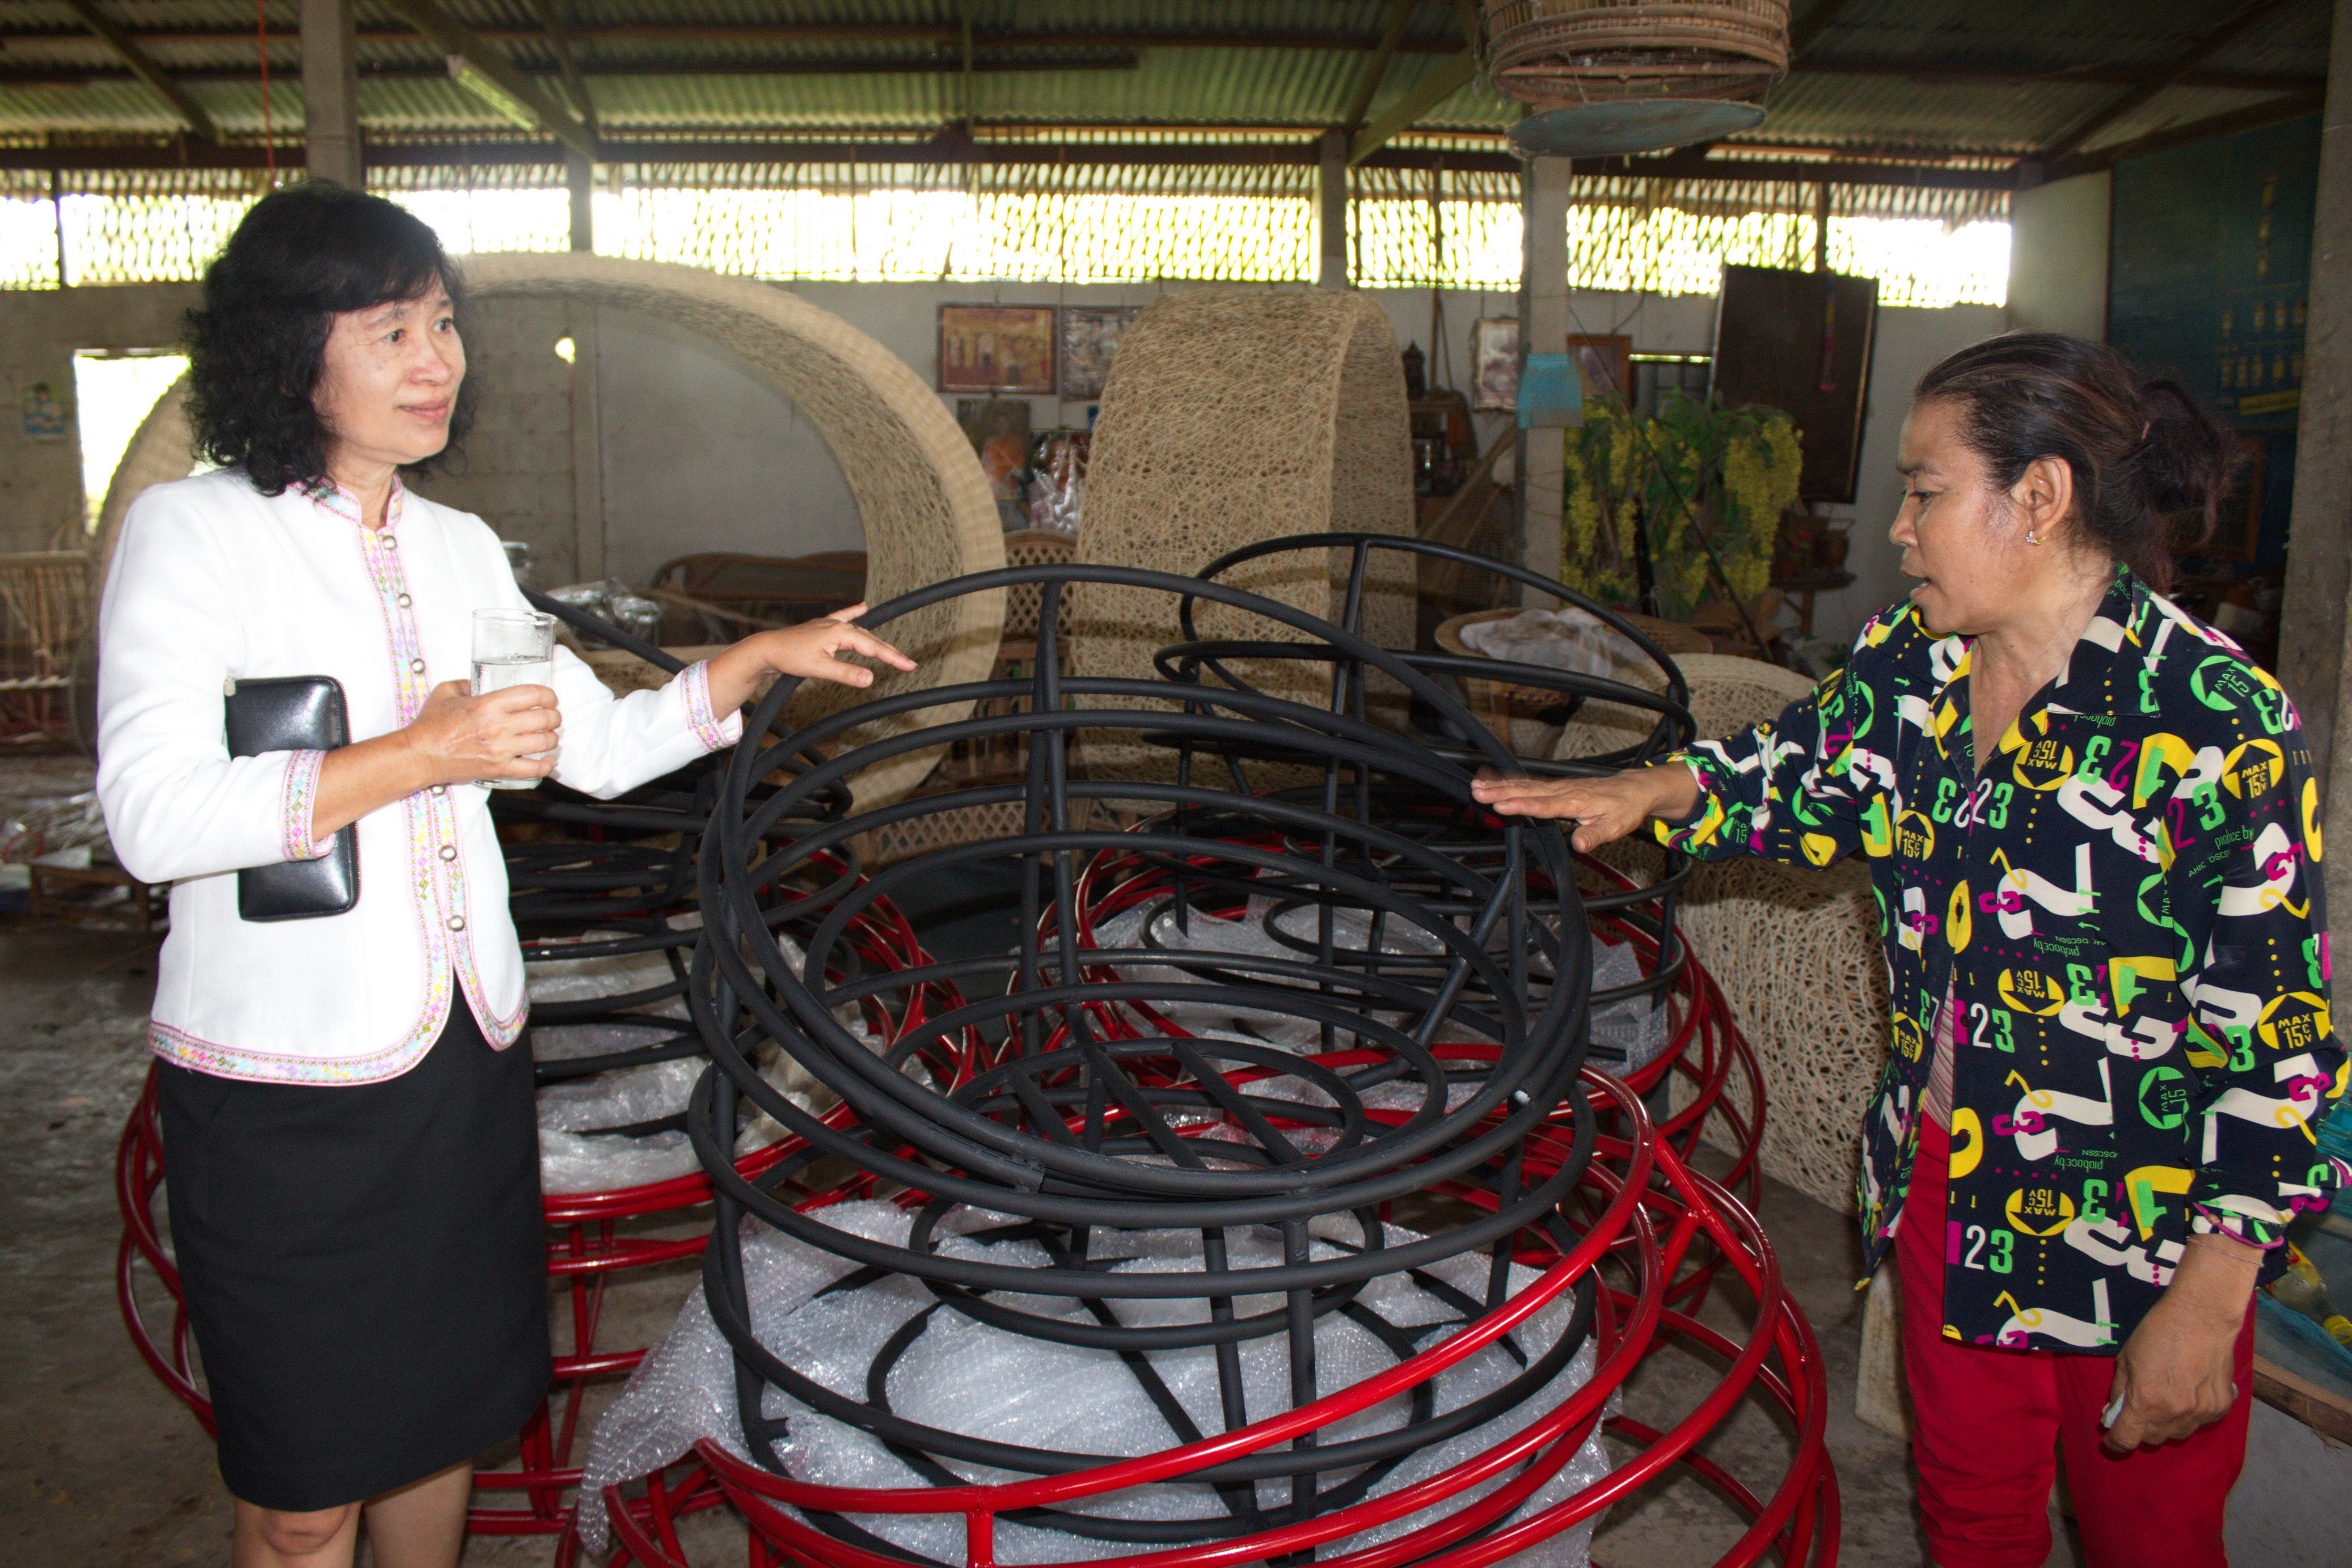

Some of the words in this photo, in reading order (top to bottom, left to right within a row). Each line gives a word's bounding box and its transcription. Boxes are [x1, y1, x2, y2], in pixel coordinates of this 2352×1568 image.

[2215, 667, 2236, 691] MAX
[2227, 675, 2250, 697] 15
[2027, 758, 2058, 770] MAX
[2241, 761, 2269, 779] MAX
[1902, 829, 1924, 843] MAX
[2017, 985, 2045, 999] MAX
[2278, 1014, 2312, 1029] MAX
[2283, 1025, 2303, 1049] 15
[2169, 1089, 2186, 1104] 15
[2024, 1206, 2056, 1216] MAX
